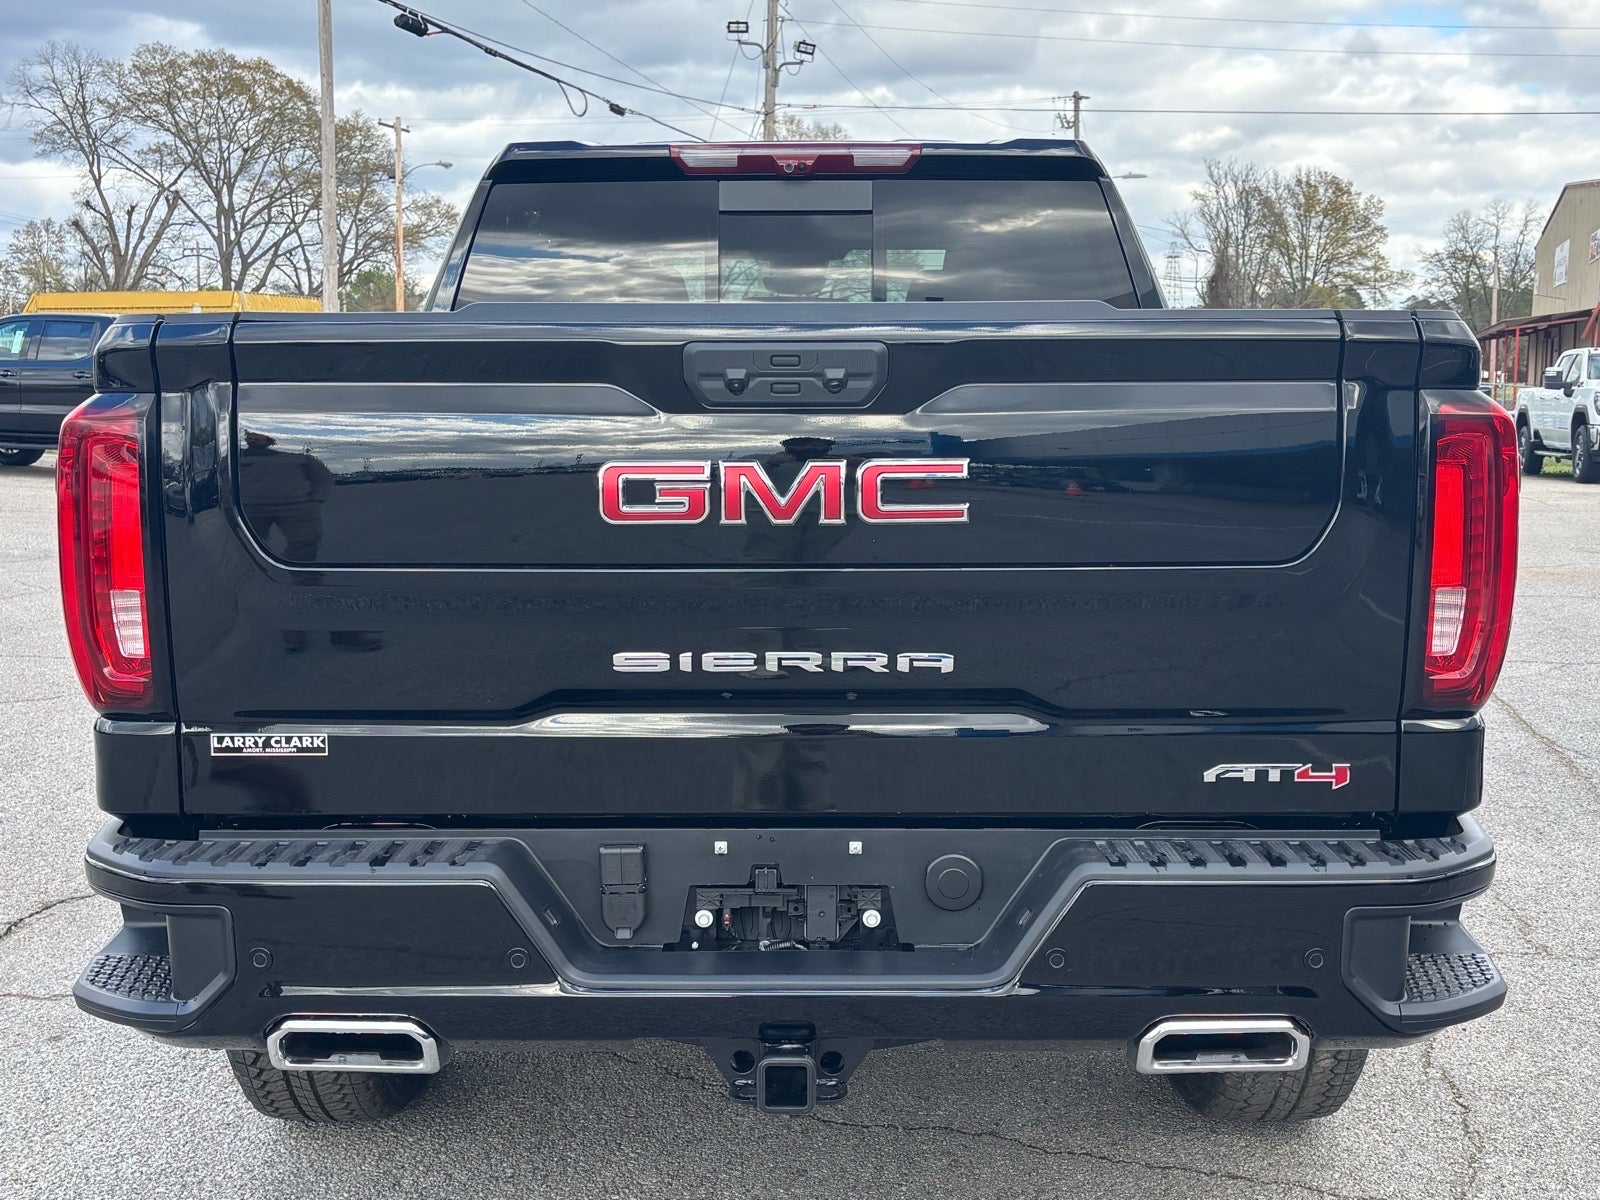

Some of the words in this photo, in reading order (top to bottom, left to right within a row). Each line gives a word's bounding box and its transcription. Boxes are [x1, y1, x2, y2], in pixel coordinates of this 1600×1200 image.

[598, 458, 970, 526] GMC
[612, 651, 955, 674] SIERRA
[213, 736, 267, 748] LARRY
[270, 736, 326, 748] CLARK
[1203, 763, 1351, 790] AT4
